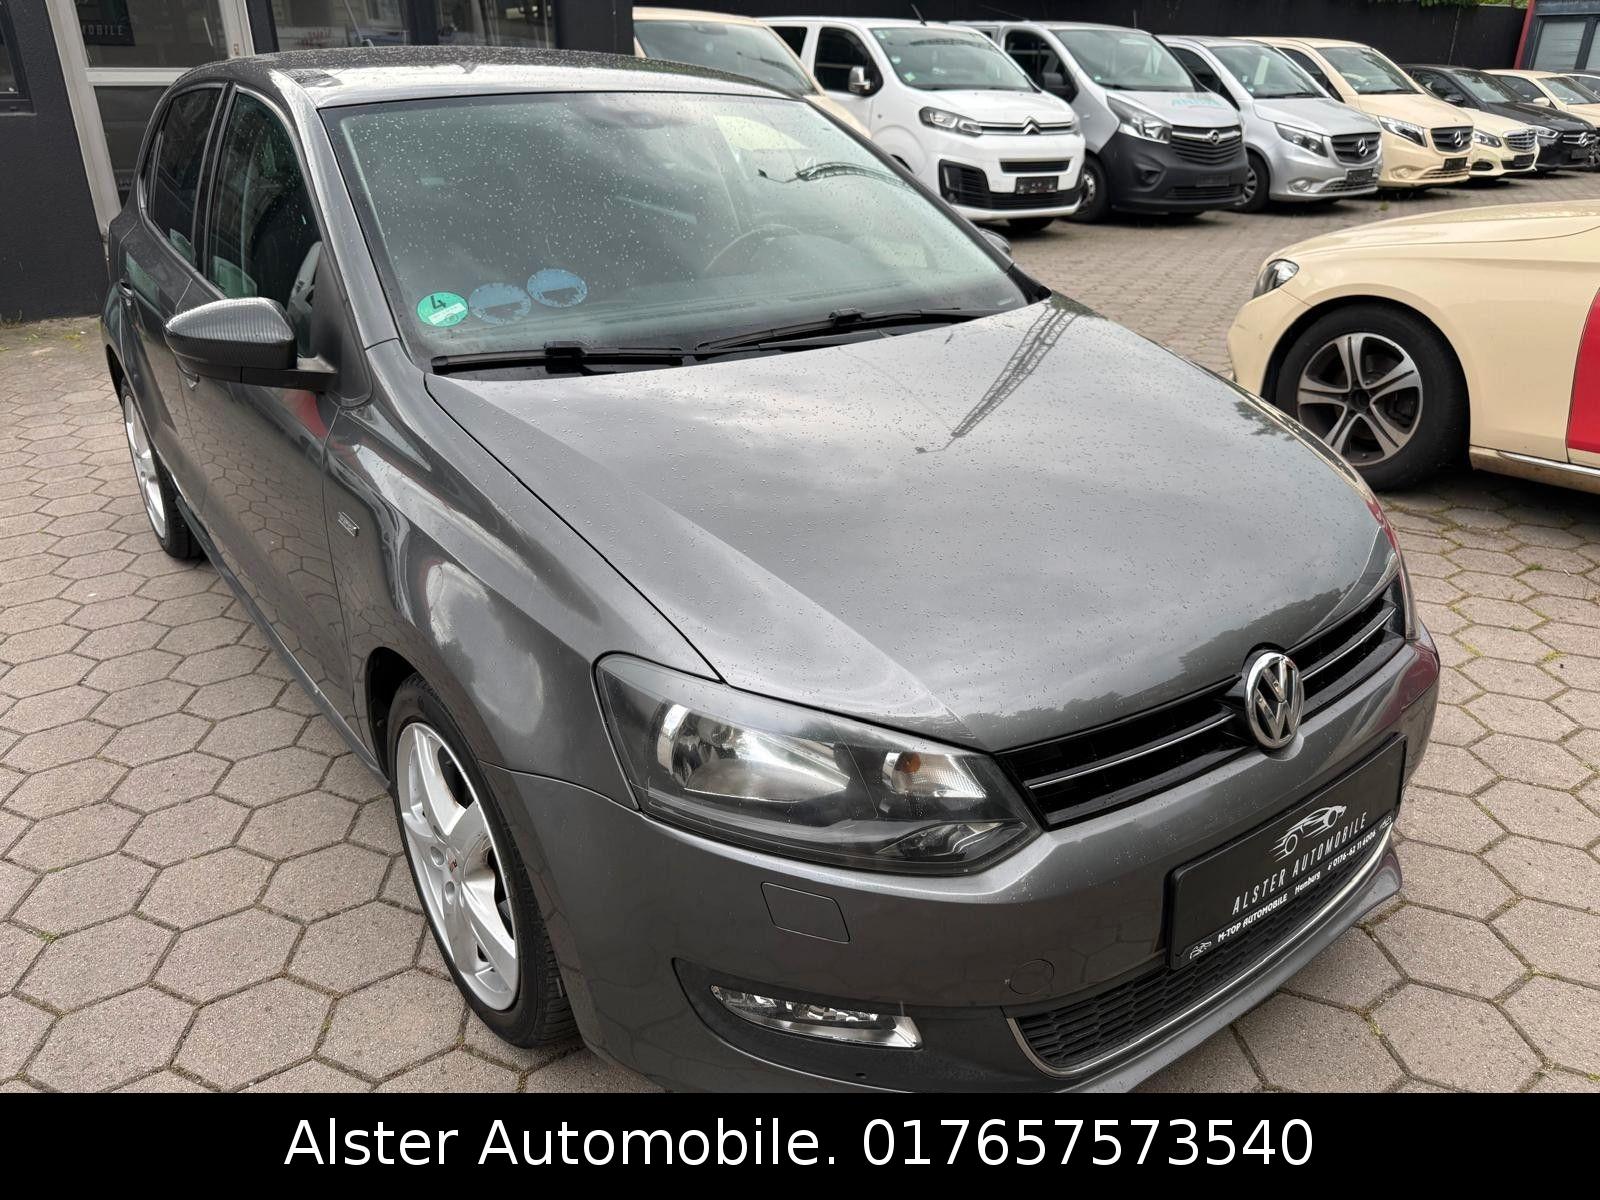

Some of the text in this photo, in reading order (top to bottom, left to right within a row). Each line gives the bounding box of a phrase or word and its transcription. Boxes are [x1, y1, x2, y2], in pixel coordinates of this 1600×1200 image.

[430, 295, 446, 309] 4
[1232, 811, 1367, 915] ALSTER AUTOMOBILE
[1217, 922, 1242, 943] M-TOP
[1242, 893, 1288, 928] AUTOMOBILE
[1294, 871, 1321, 895] Hamburg
